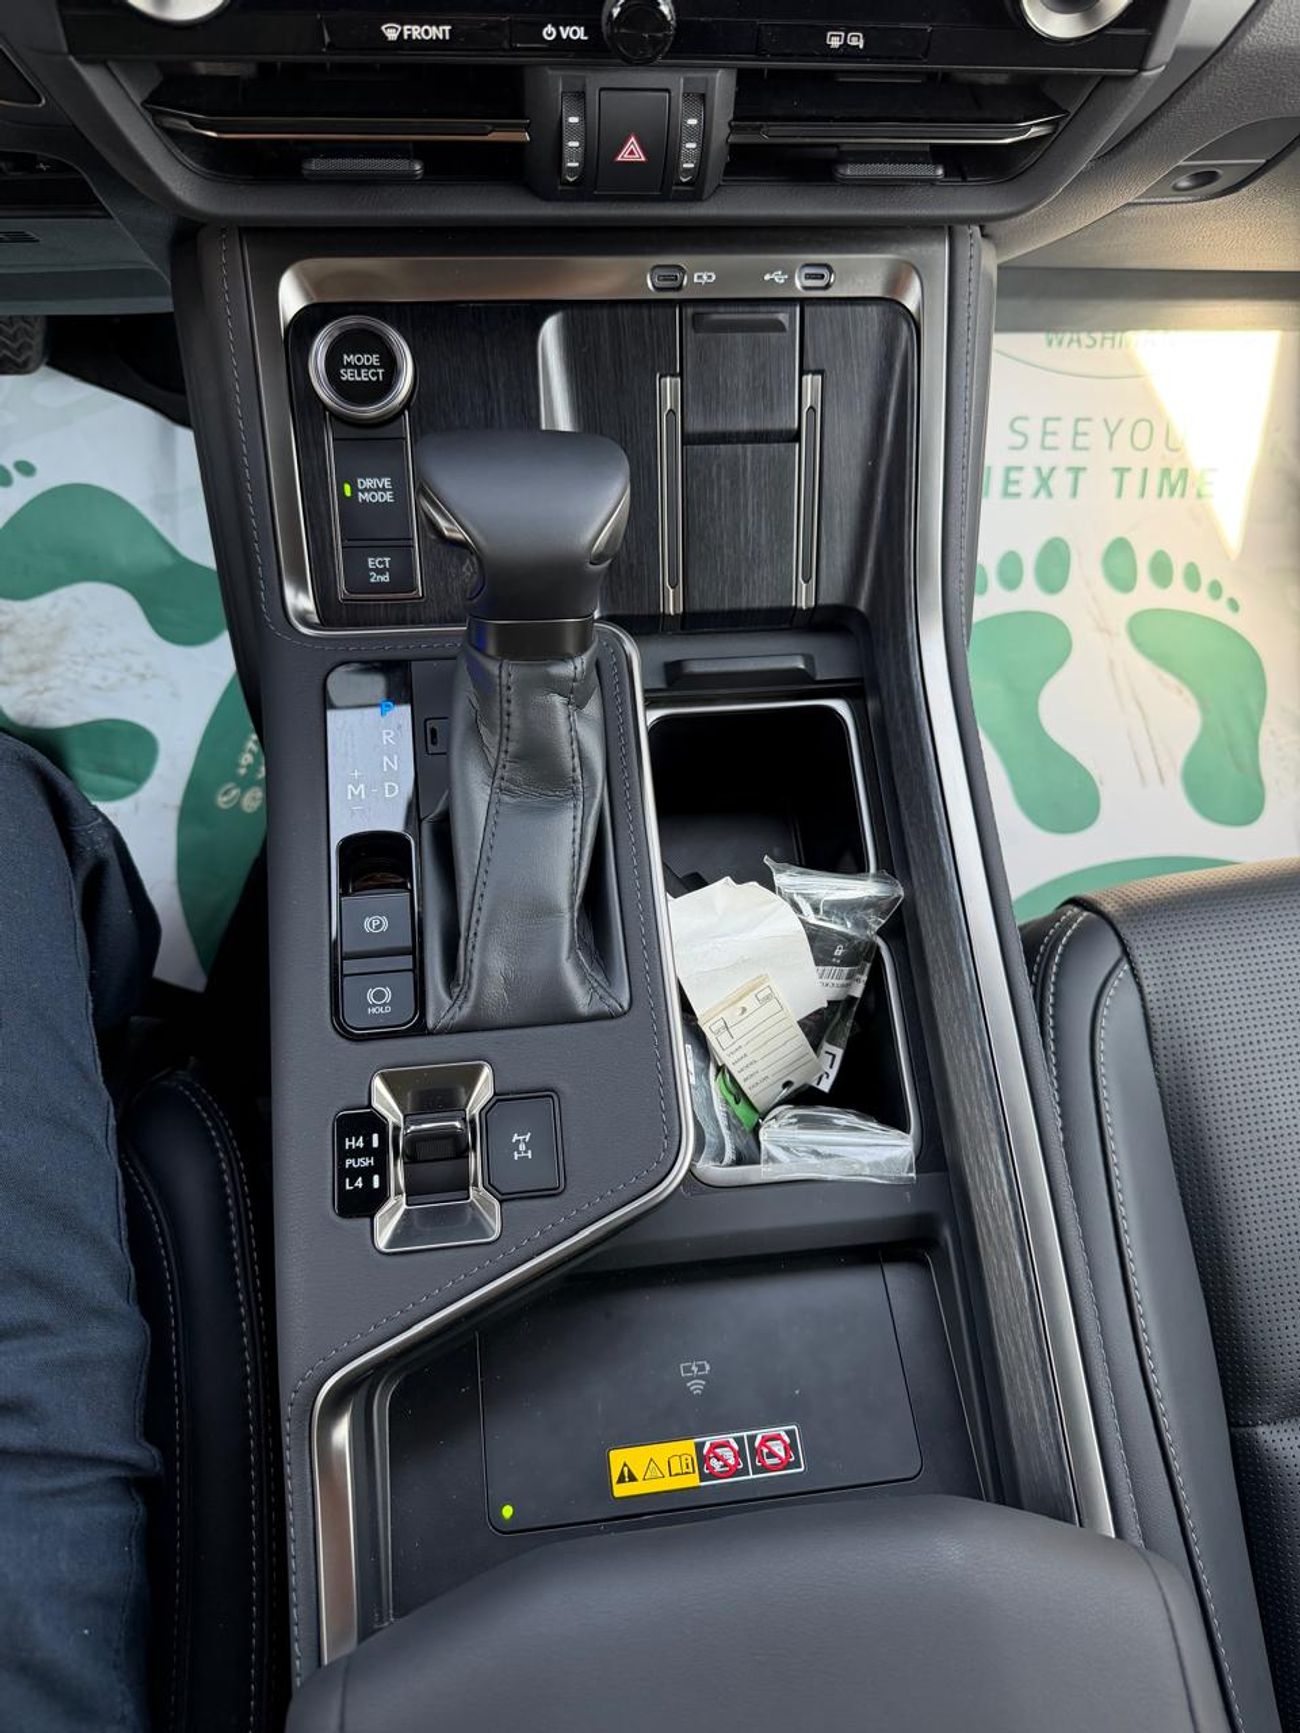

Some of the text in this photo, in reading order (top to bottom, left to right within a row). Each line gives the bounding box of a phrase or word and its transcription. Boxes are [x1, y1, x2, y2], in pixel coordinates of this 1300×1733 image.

[403, 25, 452, 41] FRONT
[559, 26, 588, 41] VOL
[343, 354, 380, 366] MODE
[340, 368, 385, 381] SELECT
[357, 477, 392, 489] DRIVE
[358, 491, 394, 503] MODE
[368, 557, 391, 569] ECT
[369, 571, 390, 583] 2nd
[380, 700, 395, 717] P
[382, 729, 395, 745] R
[383, 755, 398, 771] N
[347, 782, 399, 800] M D
[368, 1005, 391, 1015] HOLD
[345, 1135, 364, 1149] H4
[345, 1156, 374, 1168] PUSH
[345, 1176, 363, 1190] L4
